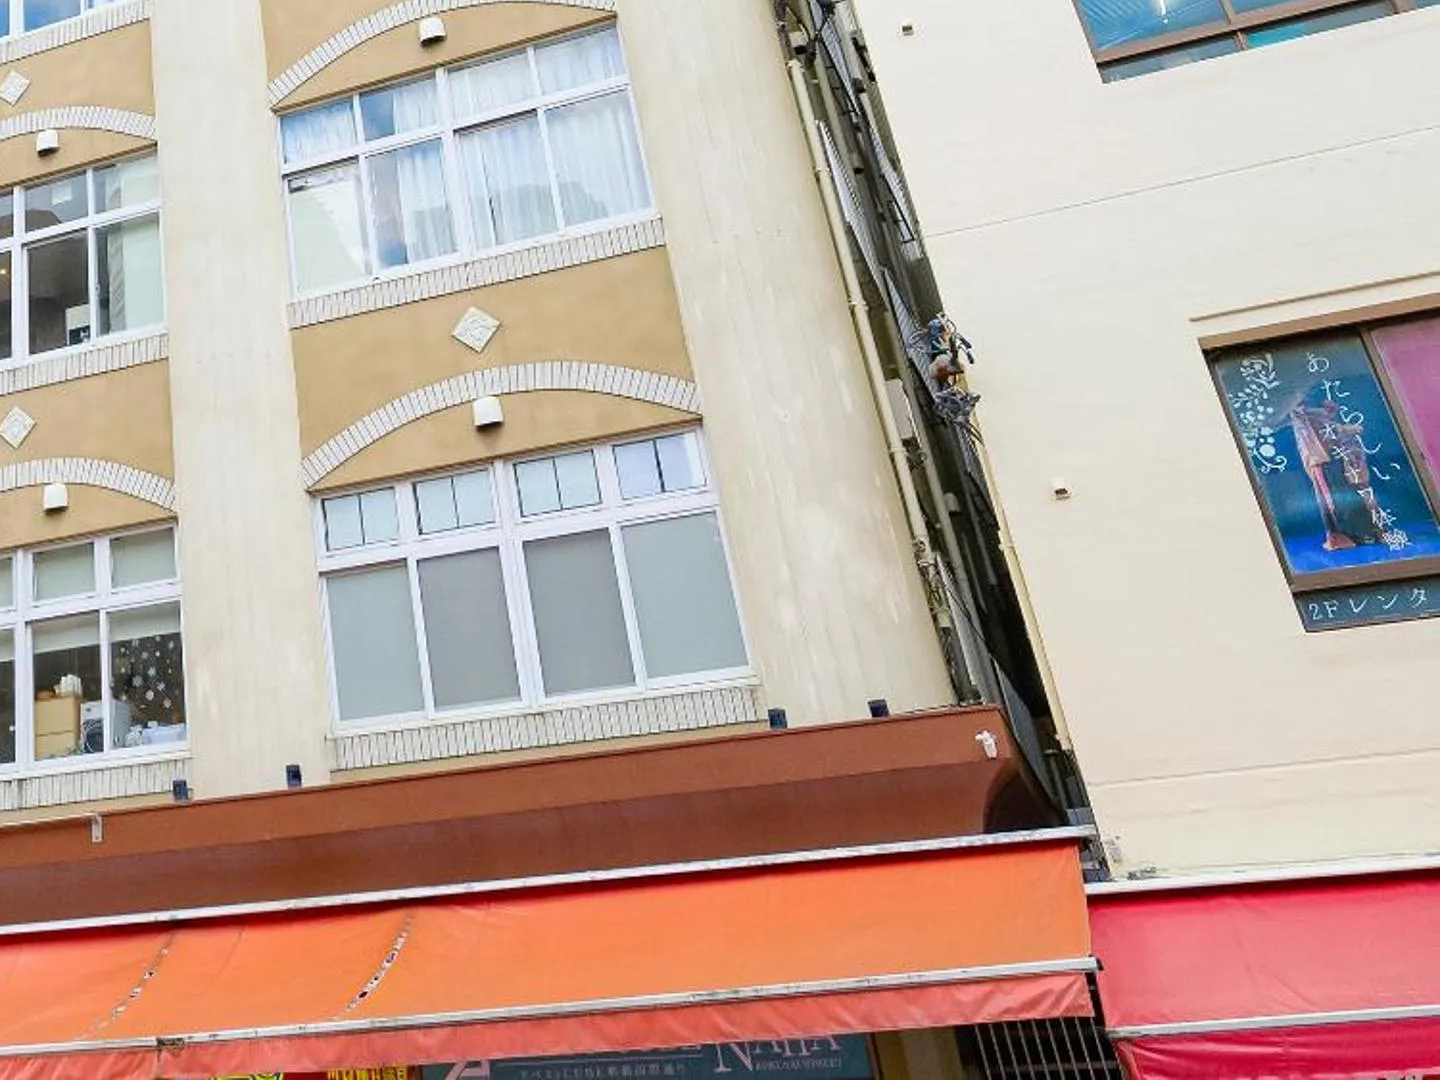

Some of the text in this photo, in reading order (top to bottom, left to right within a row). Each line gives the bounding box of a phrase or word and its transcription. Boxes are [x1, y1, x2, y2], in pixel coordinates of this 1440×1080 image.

[1307, 352, 1401, 481] あたらしい
